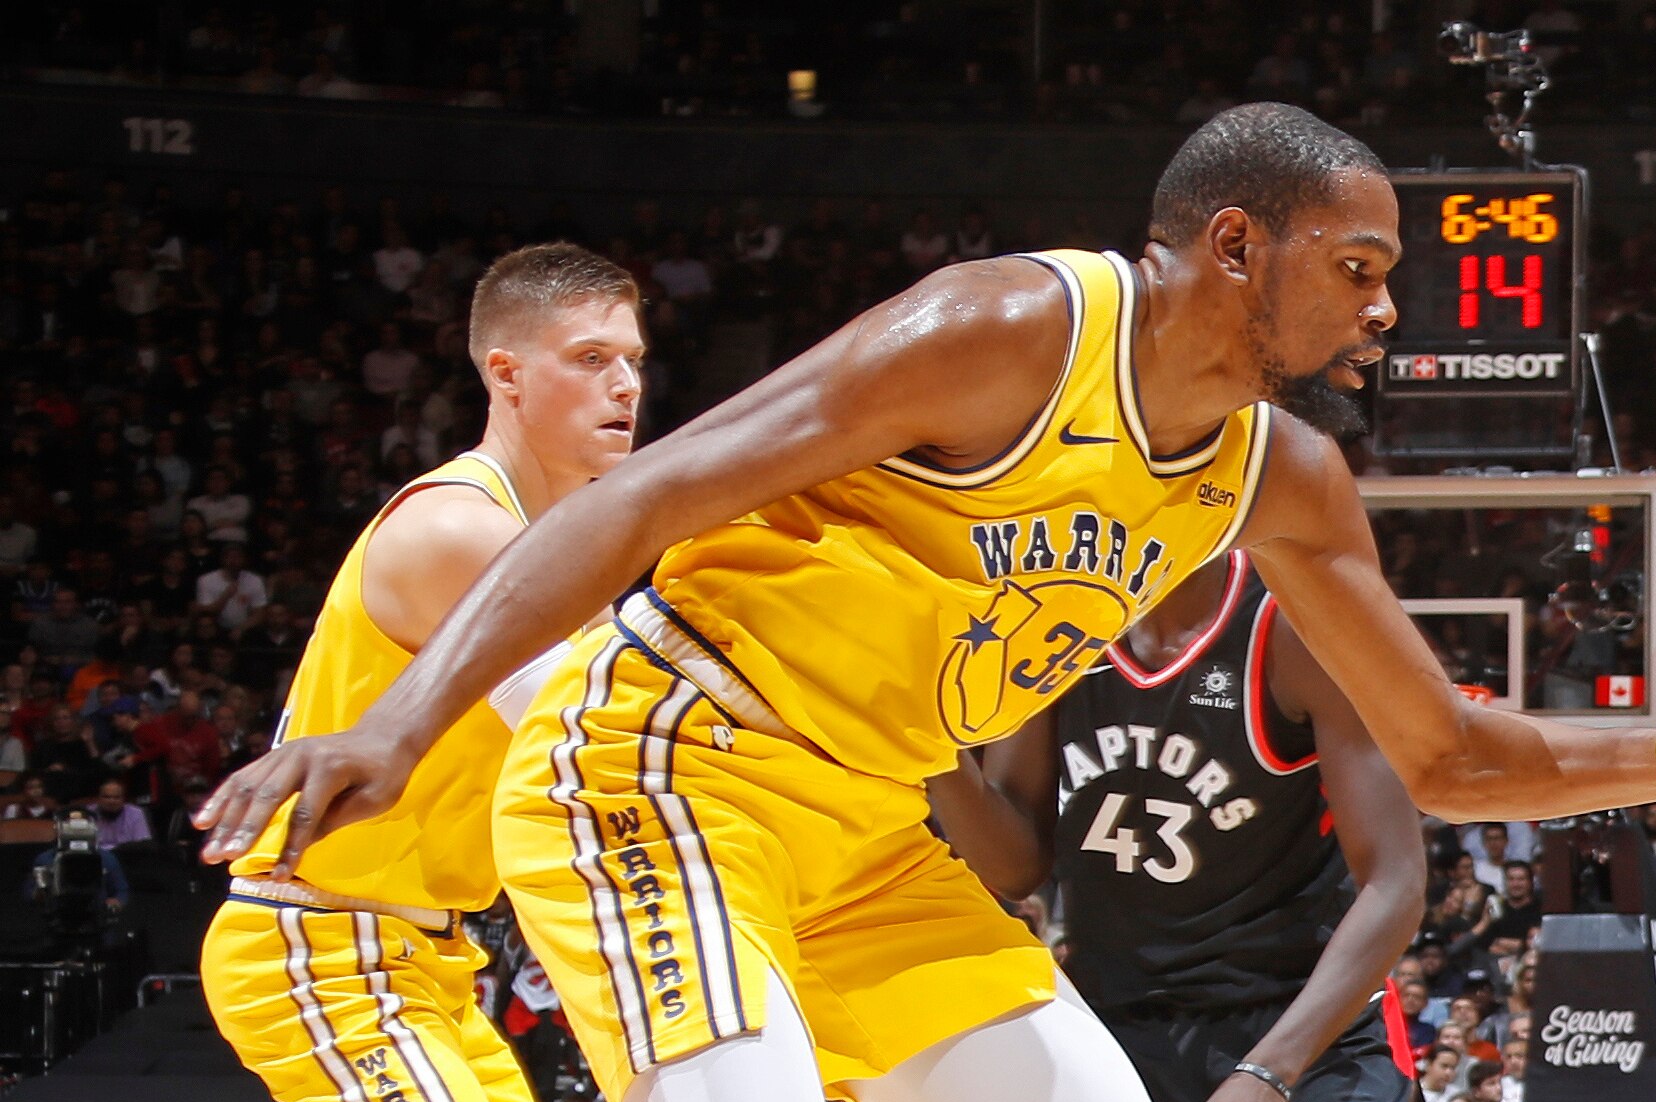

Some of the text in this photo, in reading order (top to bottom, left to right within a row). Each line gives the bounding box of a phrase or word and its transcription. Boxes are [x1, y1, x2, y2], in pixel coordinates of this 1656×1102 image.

[123, 117, 192, 154] 112
[1441, 194, 1558, 243] 6:46
[1459, 255, 1542, 328] 14
[1438, 354, 1564, 379] TISSOT
[970, 511, 1176, 609] WARRI
[1189, 694, 1238, 710] Sun Life
[1058, 724, 1256, 832] APTORS
[1080, 793, 1194, 883] 43
[607, 805, 685, 1019] WRRIORS
[1541, 1005, 1635, 1043] Season
[1544, 1034, 1645, 1073] of Giving
